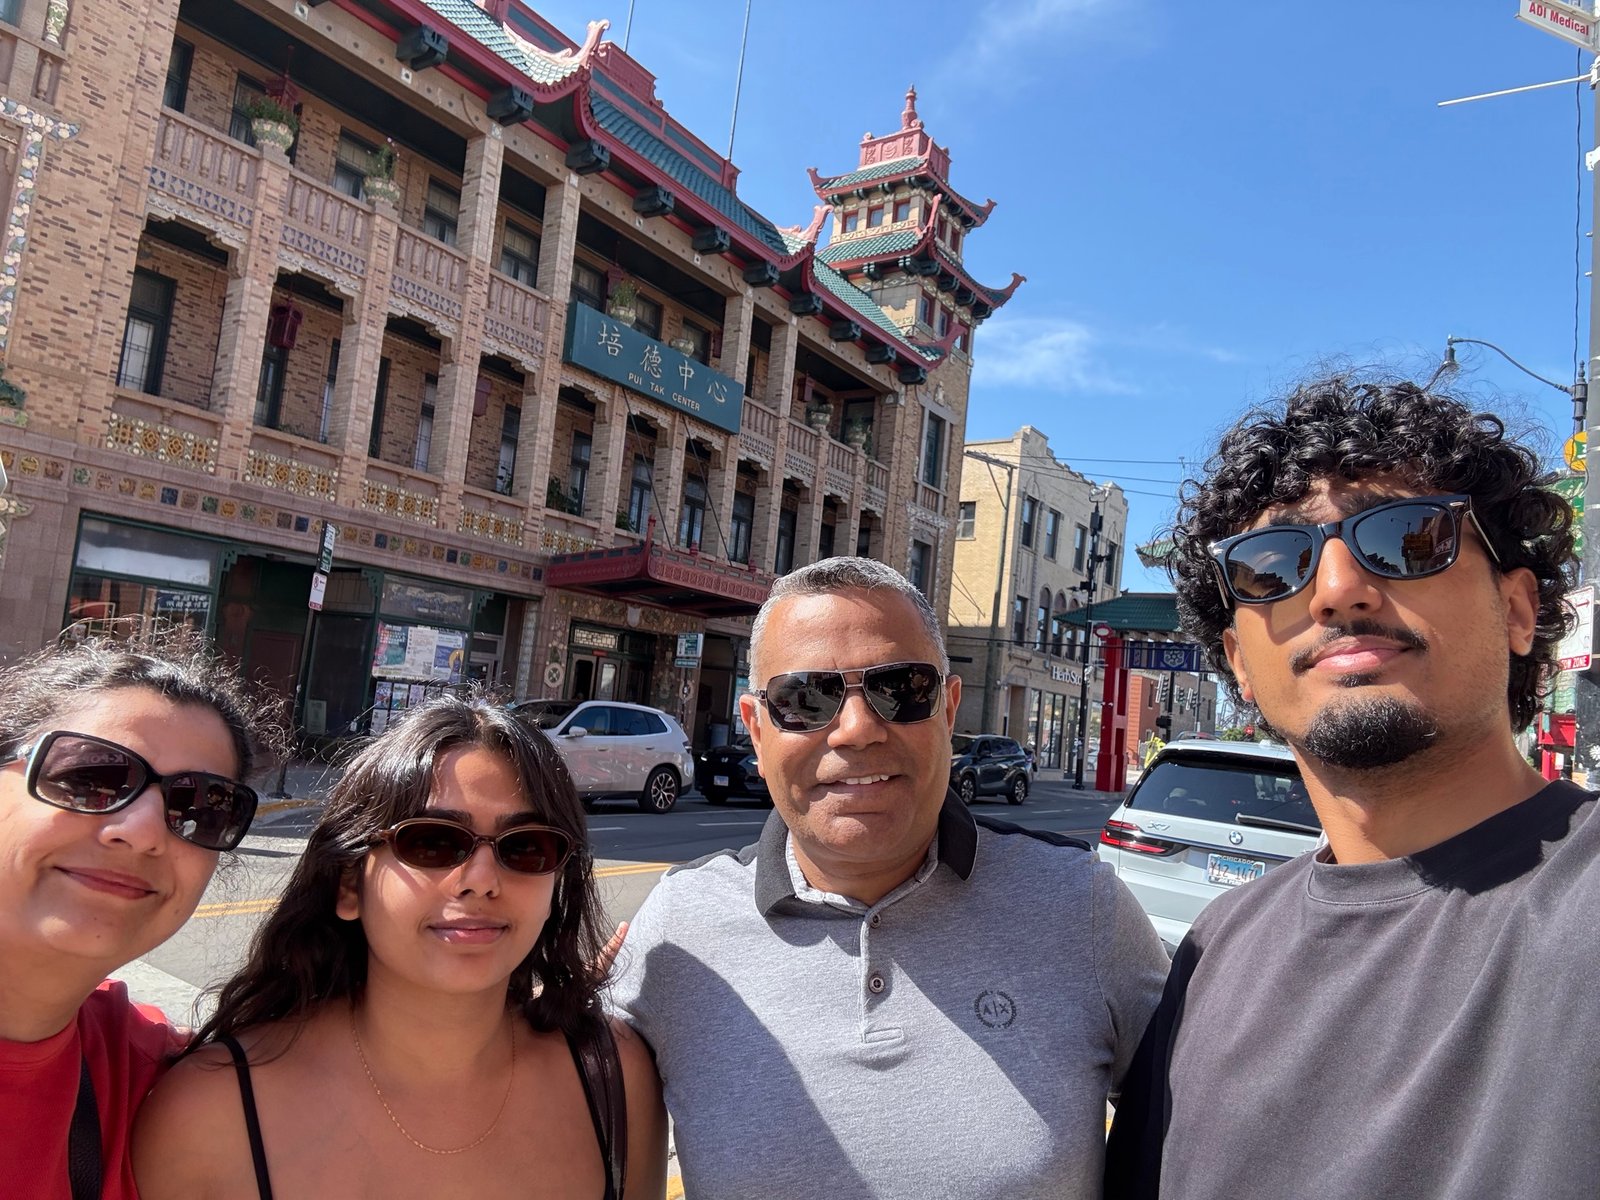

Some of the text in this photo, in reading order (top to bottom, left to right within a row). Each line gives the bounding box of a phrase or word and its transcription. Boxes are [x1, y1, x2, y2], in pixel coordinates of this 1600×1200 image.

[1529, 2, 1589, 36] ADI Medical
[597, 320, 728, 404] 培德中心
[628, 372, 701, 412] PUI TAK CENTER
[1573, 655, 1588, 668] ZONE
[1148, 821, 1170, 831] X7
